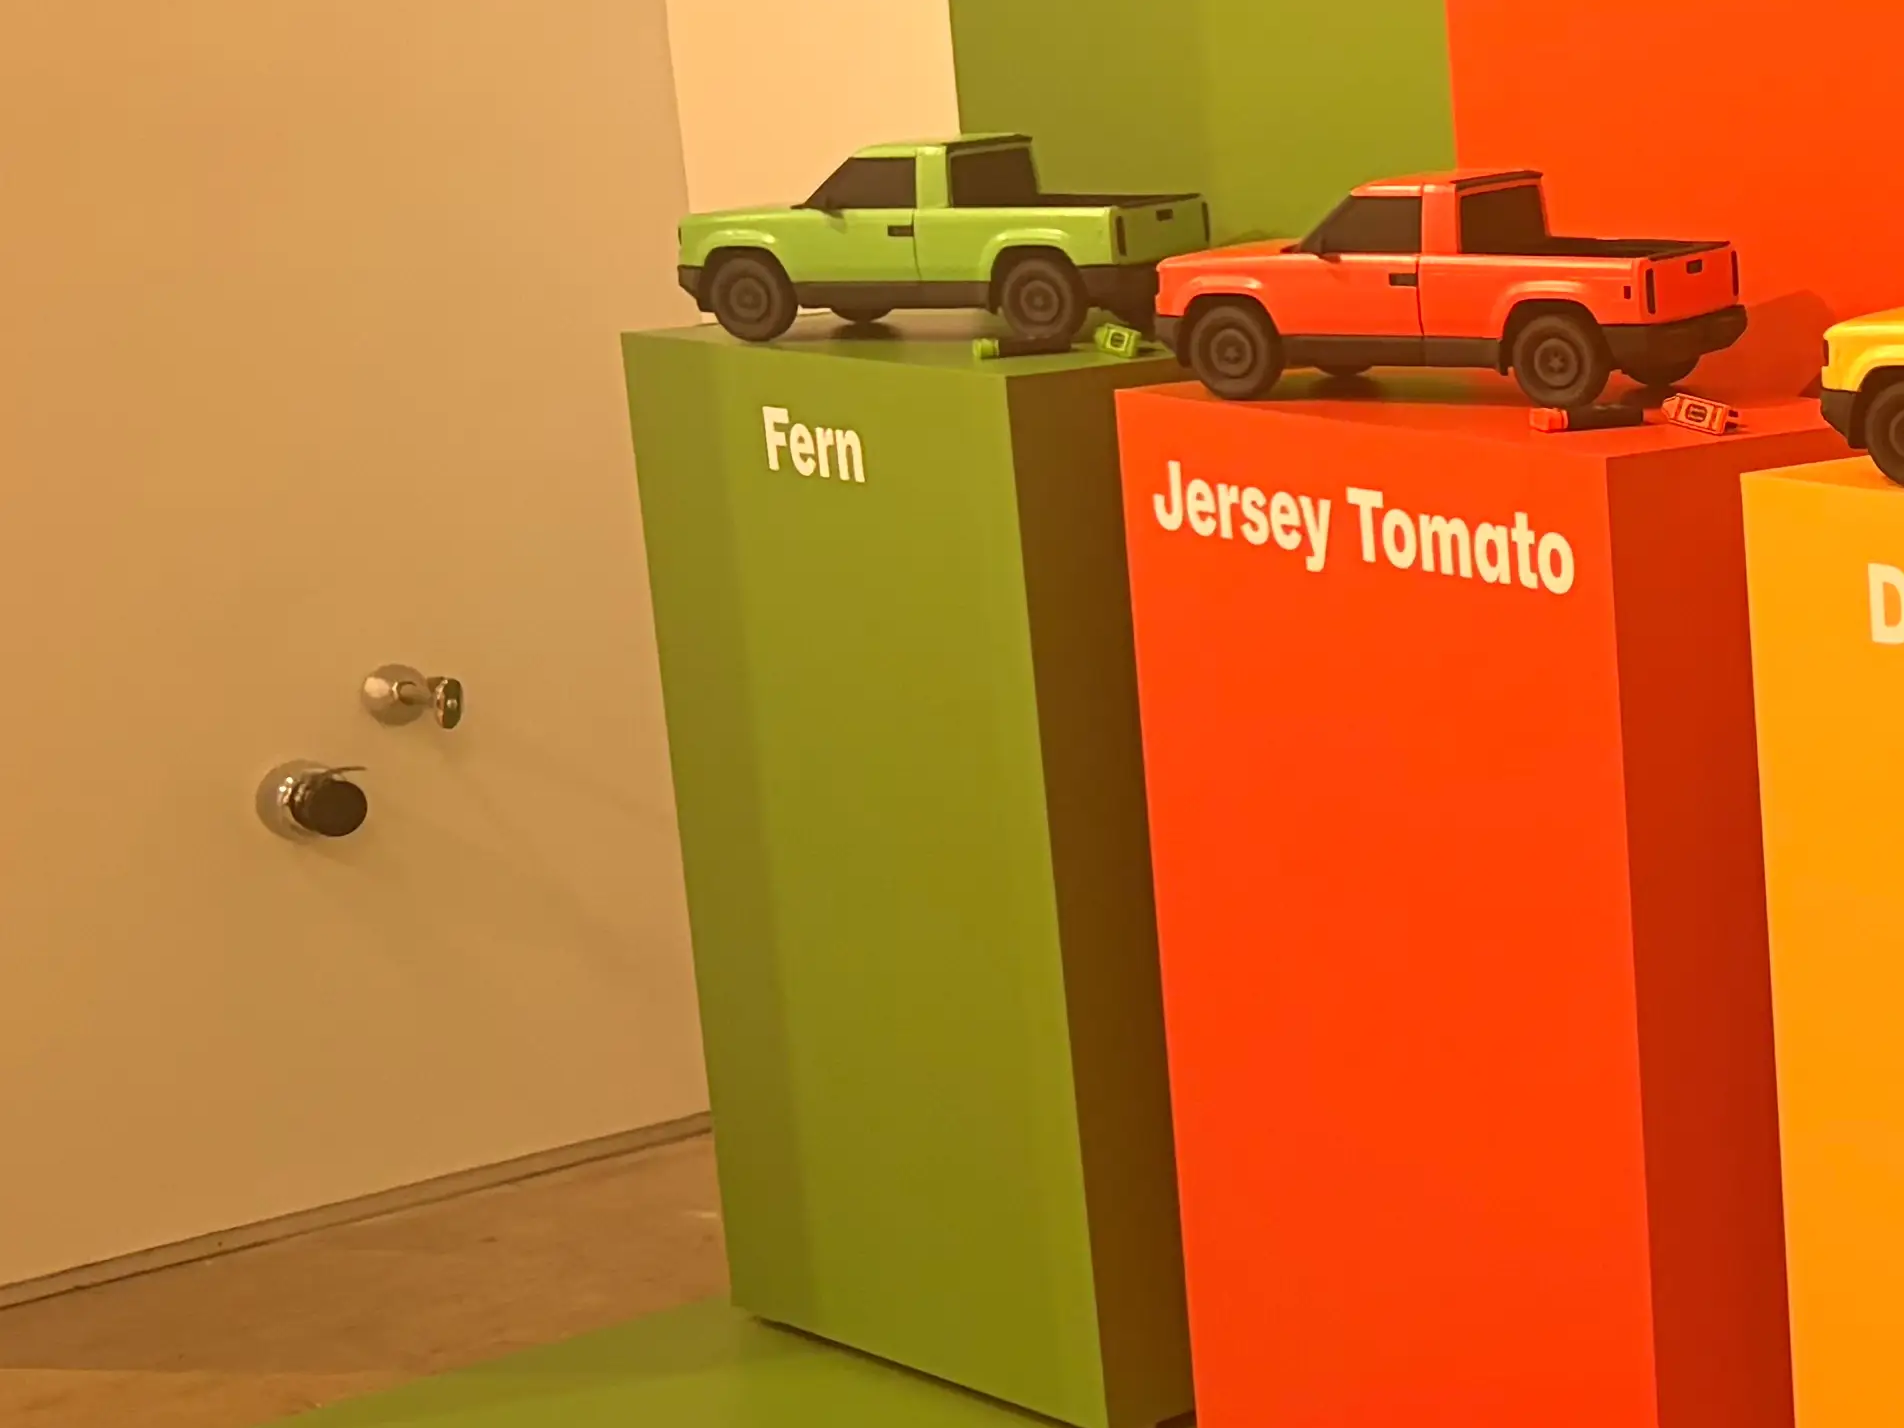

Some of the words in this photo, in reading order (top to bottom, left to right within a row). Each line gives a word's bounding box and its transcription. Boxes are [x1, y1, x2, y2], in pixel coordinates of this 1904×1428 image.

[762, 405, 866, 483] Fern
[1153, 460, 1331, 572] Jersey
[1346, 487, 1575, 594] Tomato
